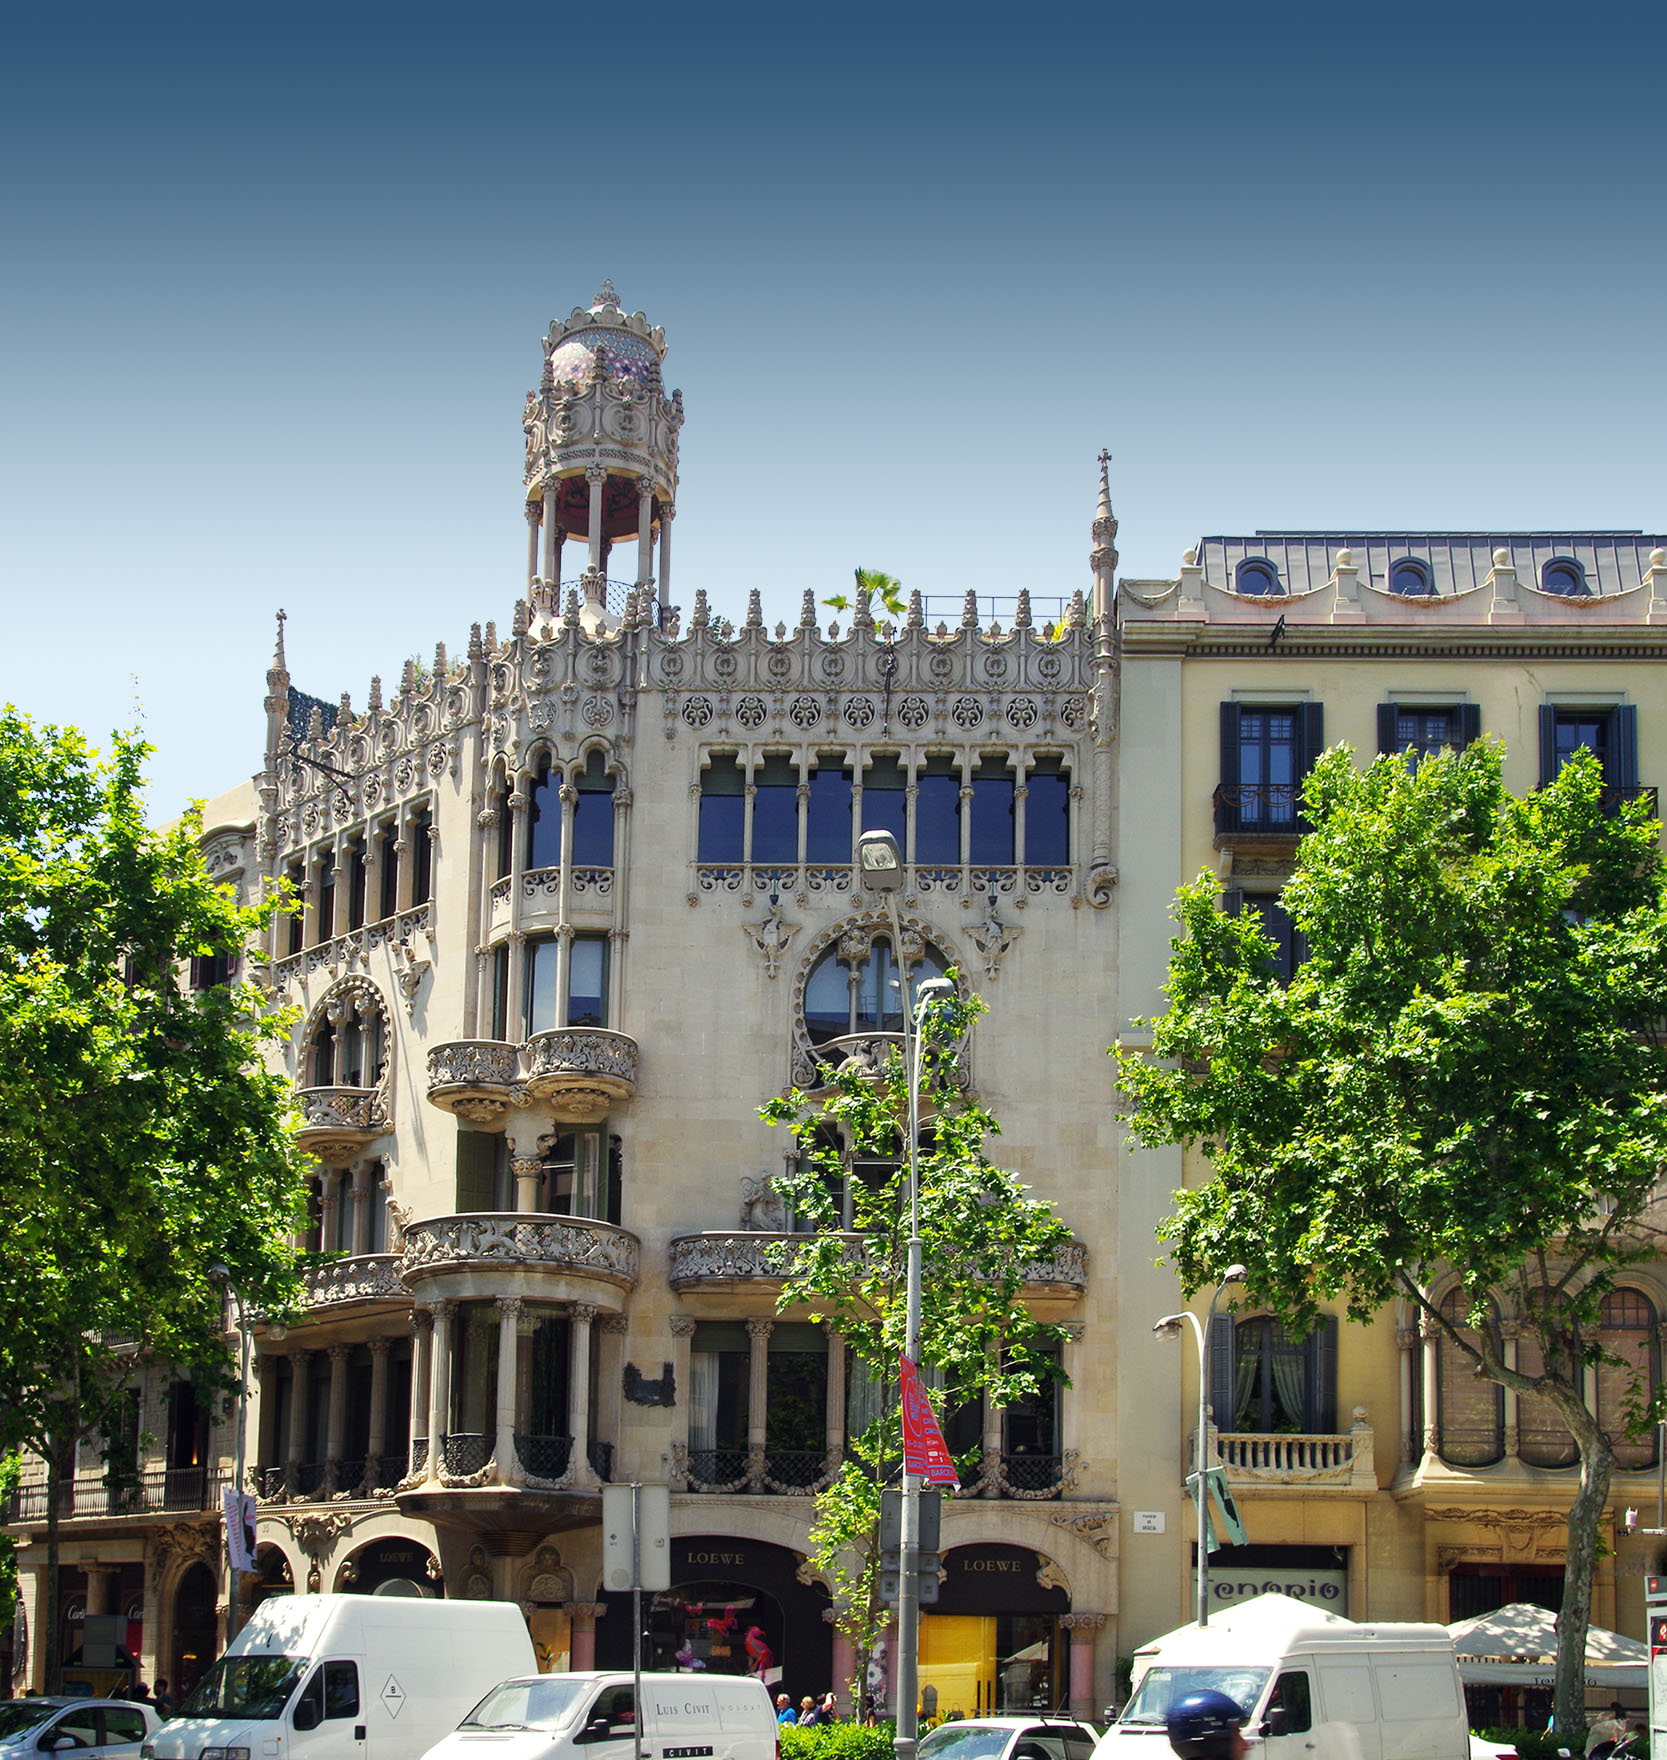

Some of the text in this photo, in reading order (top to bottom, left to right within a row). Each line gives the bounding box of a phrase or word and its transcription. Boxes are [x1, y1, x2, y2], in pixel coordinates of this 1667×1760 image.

[379, 1552, 414, 1563] LOEWE
[688, 1552, 745, 1565] LOEWE
[963, 1560, 1022, 1572] LOEWE
[668, 1747, 708, 1757] CIVIT
